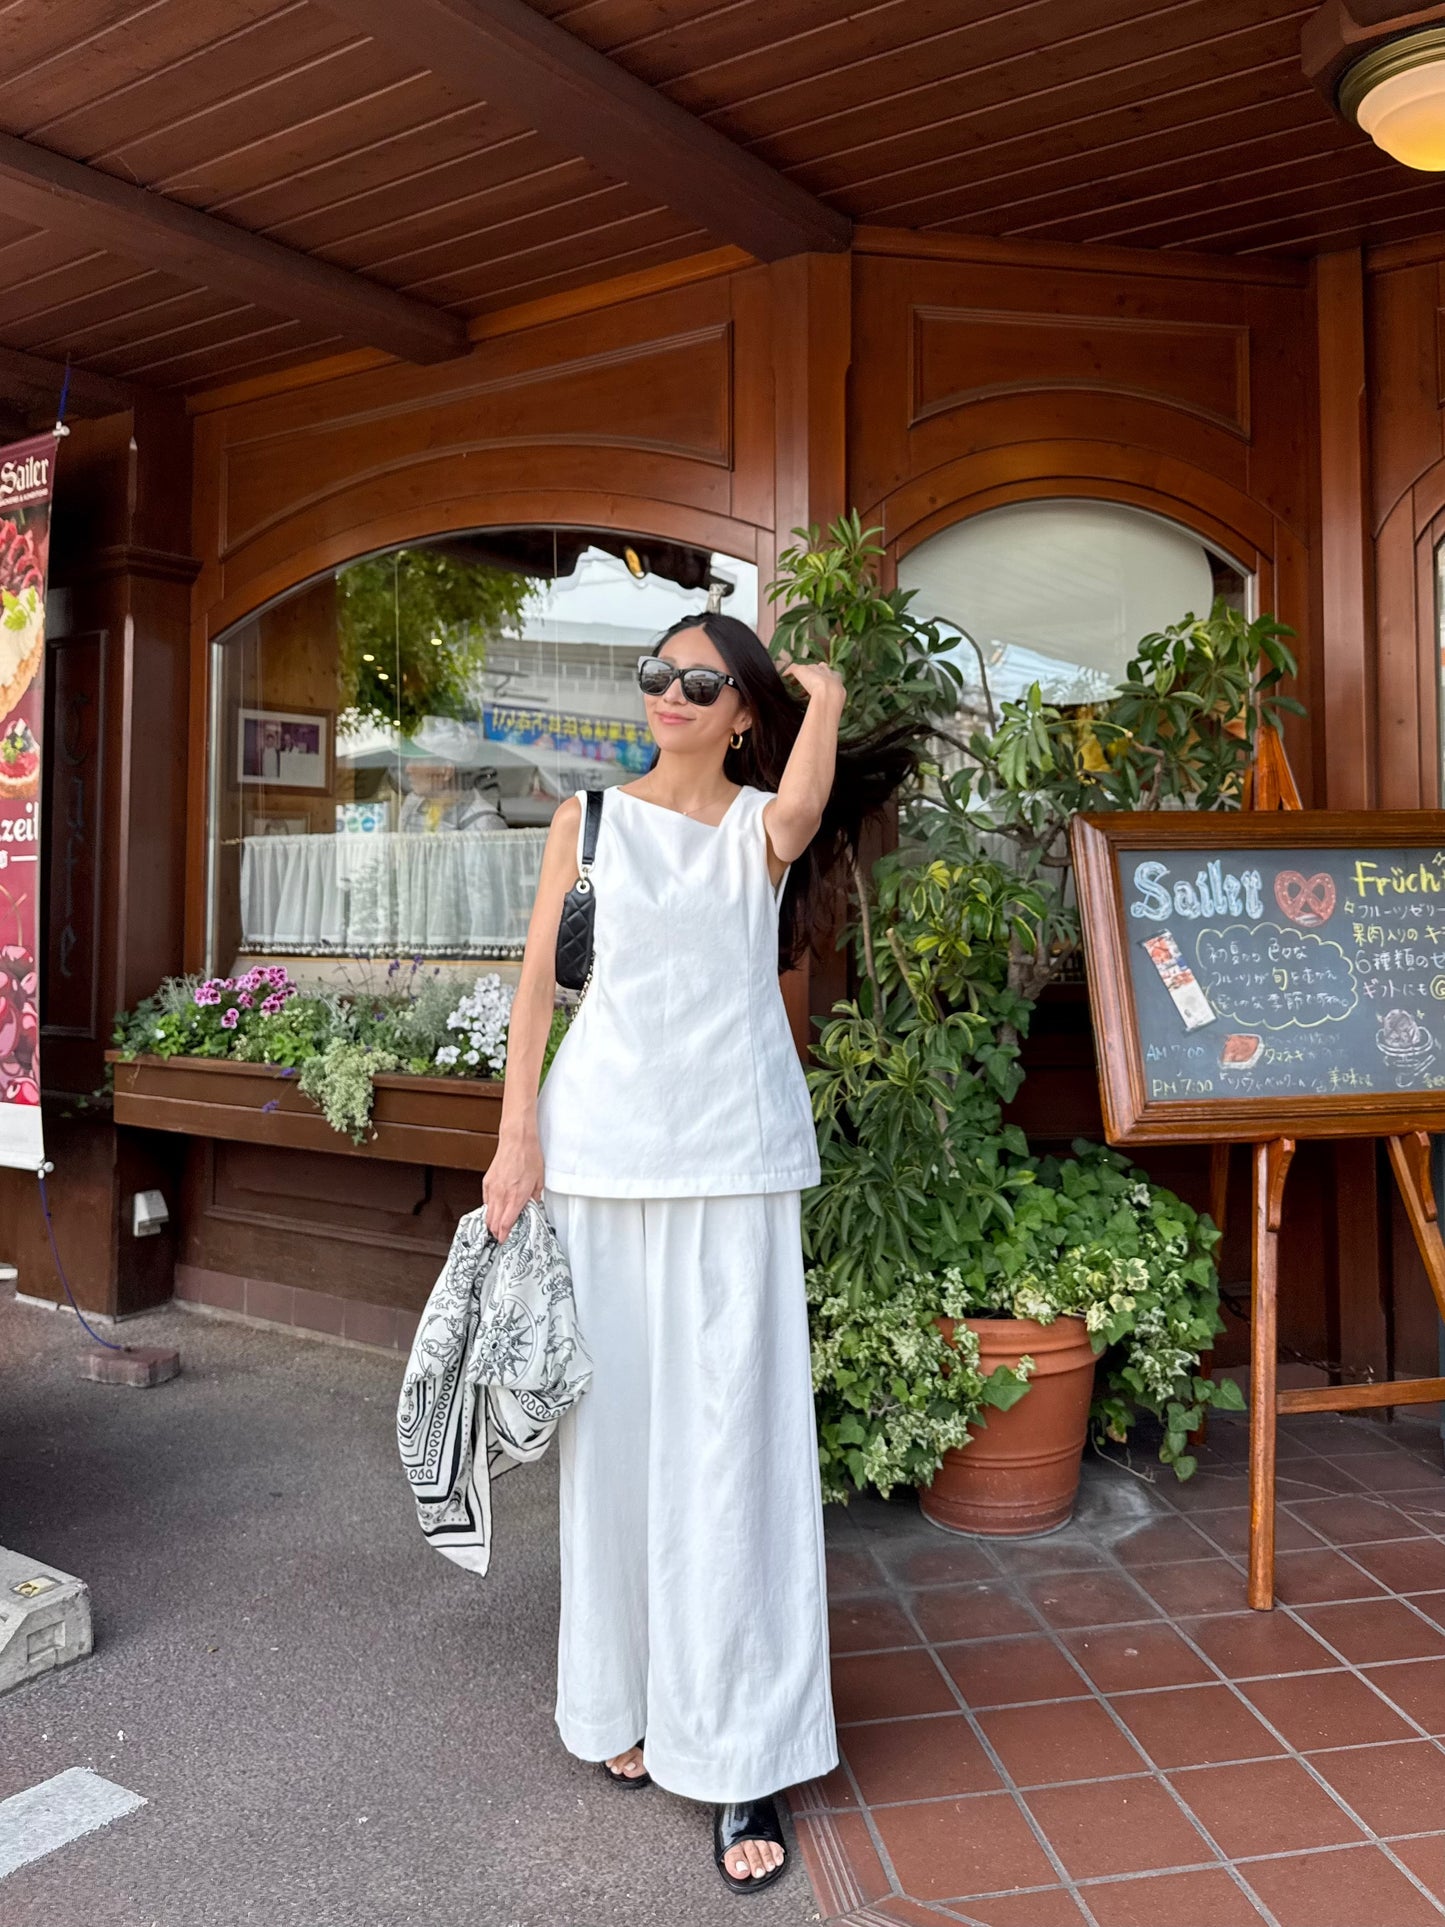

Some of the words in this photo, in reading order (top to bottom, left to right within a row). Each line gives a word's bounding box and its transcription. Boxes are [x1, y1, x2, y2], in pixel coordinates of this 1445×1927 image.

[0, 456, 49, 494] Sailer
[1130, 859, 1264, 921] Sailer
[1147, 1044, 1167, 1061] AM
[1152, 1079, 1177, 1097] PM
[1181, 1078, 1213, 1095] 7:00
